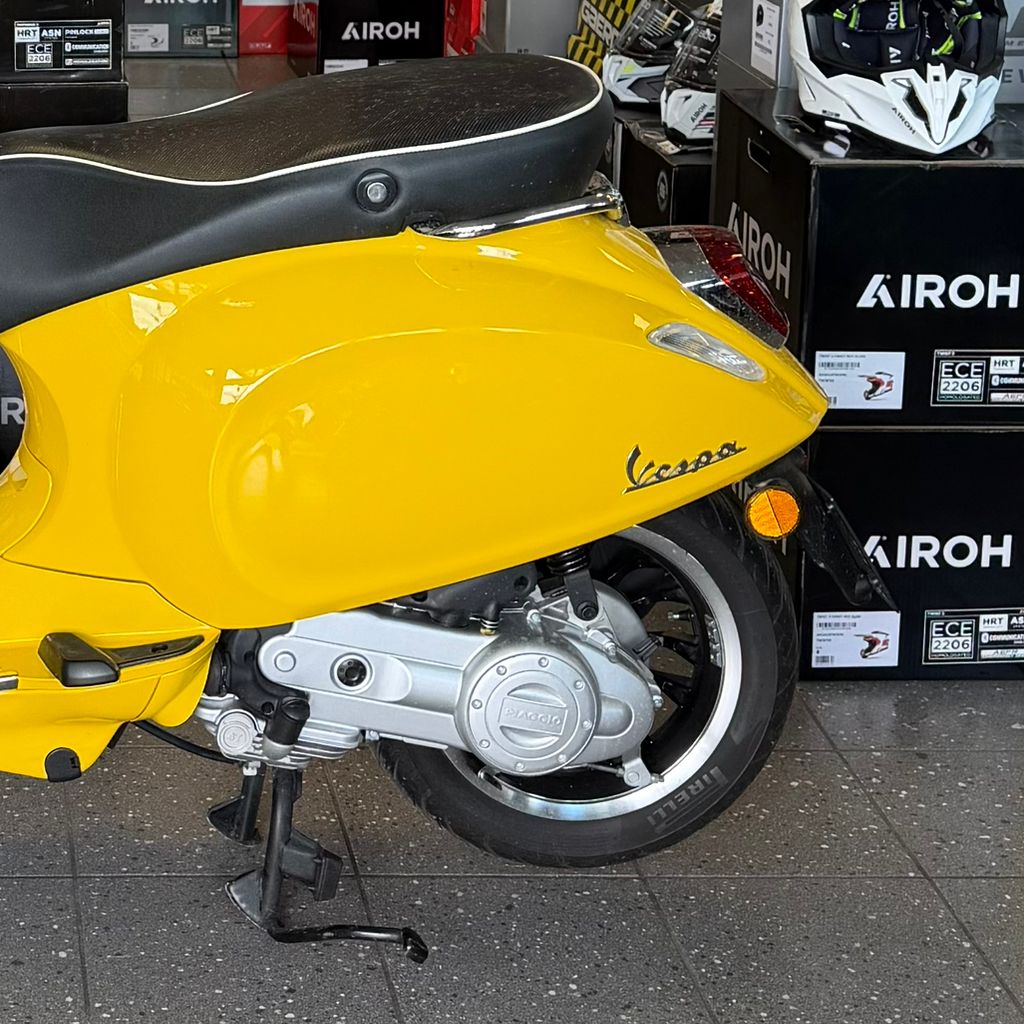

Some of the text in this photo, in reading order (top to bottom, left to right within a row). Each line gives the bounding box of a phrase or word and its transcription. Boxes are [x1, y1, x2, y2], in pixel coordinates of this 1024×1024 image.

[17, 28, 38, 38] HRT
[41, 28, 62, 38] ASN
[341, 21, 420, 40] AIROH
[27, 44, 51, 54] ECE
[27, 54, 51, 63] 2206
[891, 107, 916, 135] AIROH
[856, 274, 1021, 308] AIROH
[941, 362, 983, 378] ECE
[993, 359, 1015, 368] HRT
[942, 381, 980, 392] 2206
[622, 440, 748, 495] Vespa
[863, 534, 1013, 569] AIROH
[932, 621, 973, 637] ECE
[983, 618, 1004, 626] HRT
[933, 639, 970, 650] 2206
[503, 706, 562, 727] PIAGGIO
[646, 765, 726, 834] PIRELLI
